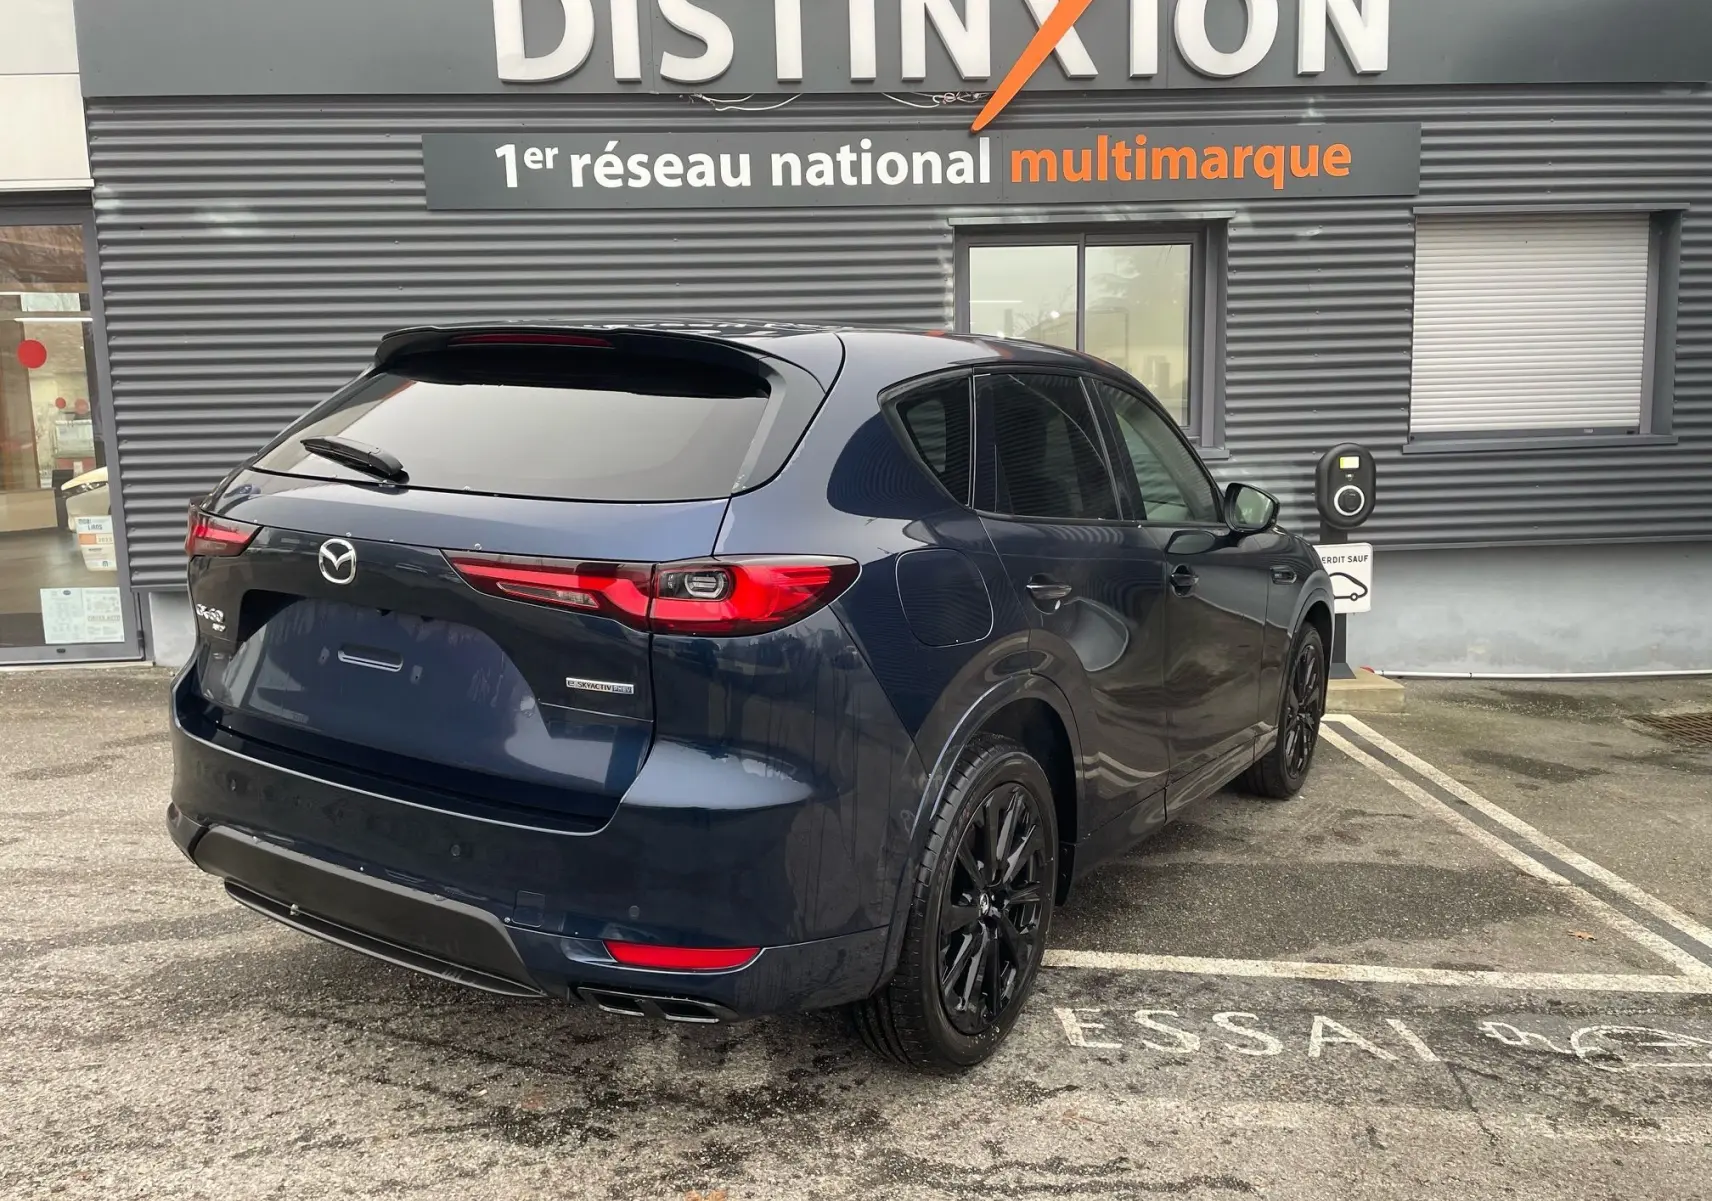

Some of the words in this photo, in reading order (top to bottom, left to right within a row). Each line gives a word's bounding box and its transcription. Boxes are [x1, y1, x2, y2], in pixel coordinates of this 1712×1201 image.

[494, 0, 1390, 132] DISTINXION
[495, 143, 559, 188] 1er
[570, 140, 752, 188] réseau
[771, 136, 991, 186] national
[1011, 134, 1352, 190] multimarque
[1321, 556, 1345, 564] ERDIT
[1347, 554, 1368, 563] SAUF
[577, 681, 611, 690] SKYACTIV
[1053, 1007, 1441, 1062] ESSAI
